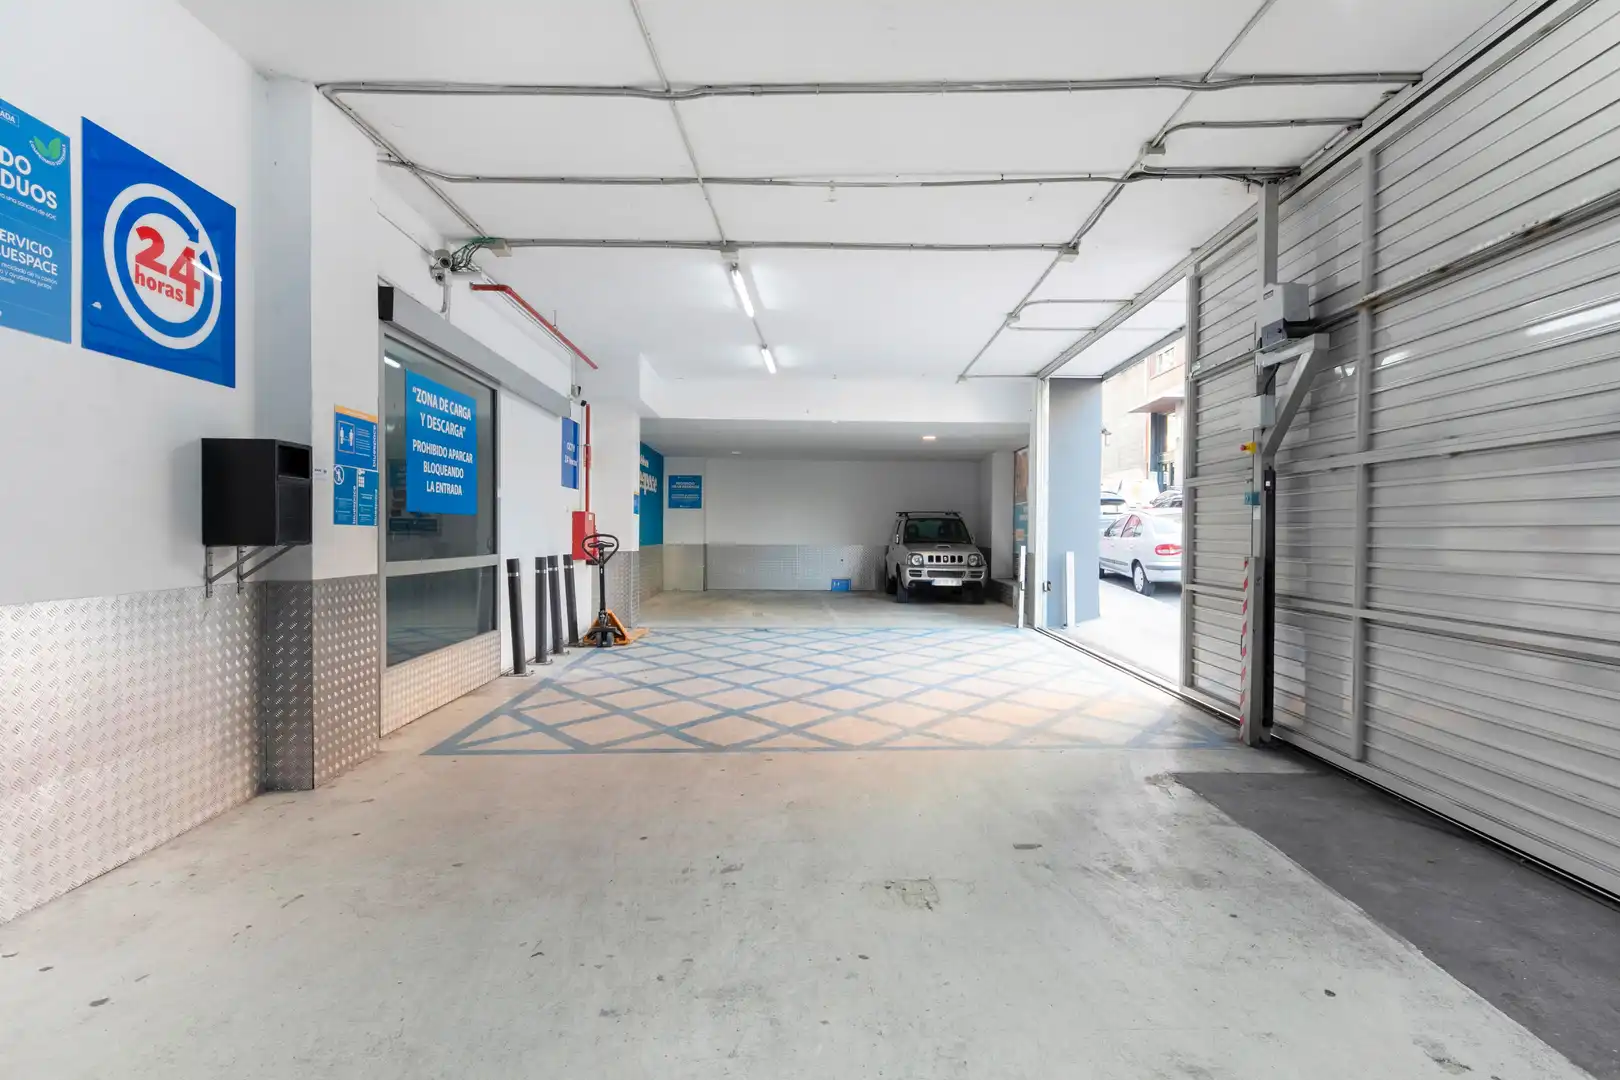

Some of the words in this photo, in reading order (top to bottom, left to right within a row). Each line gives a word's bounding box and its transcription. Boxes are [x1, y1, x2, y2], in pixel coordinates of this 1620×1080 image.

[0, 244, 58, 276] UESPACE
[135, 225, 201, 307] 24
[135, 263, 184, 302] horas
[420, 412, 426, 427] Y
[439, 397, 449, 413] DE
[449, 401, 472, 421] CARGA
[412, 439, 448, 459] PROHIBIDO
[448, 448, 473, 464] APARCAR
[423, 461, 464, 479] BLOQUEANDO
[426, 481, 435, 493] LA
[435, 482, 463, 496] ENTRADA
